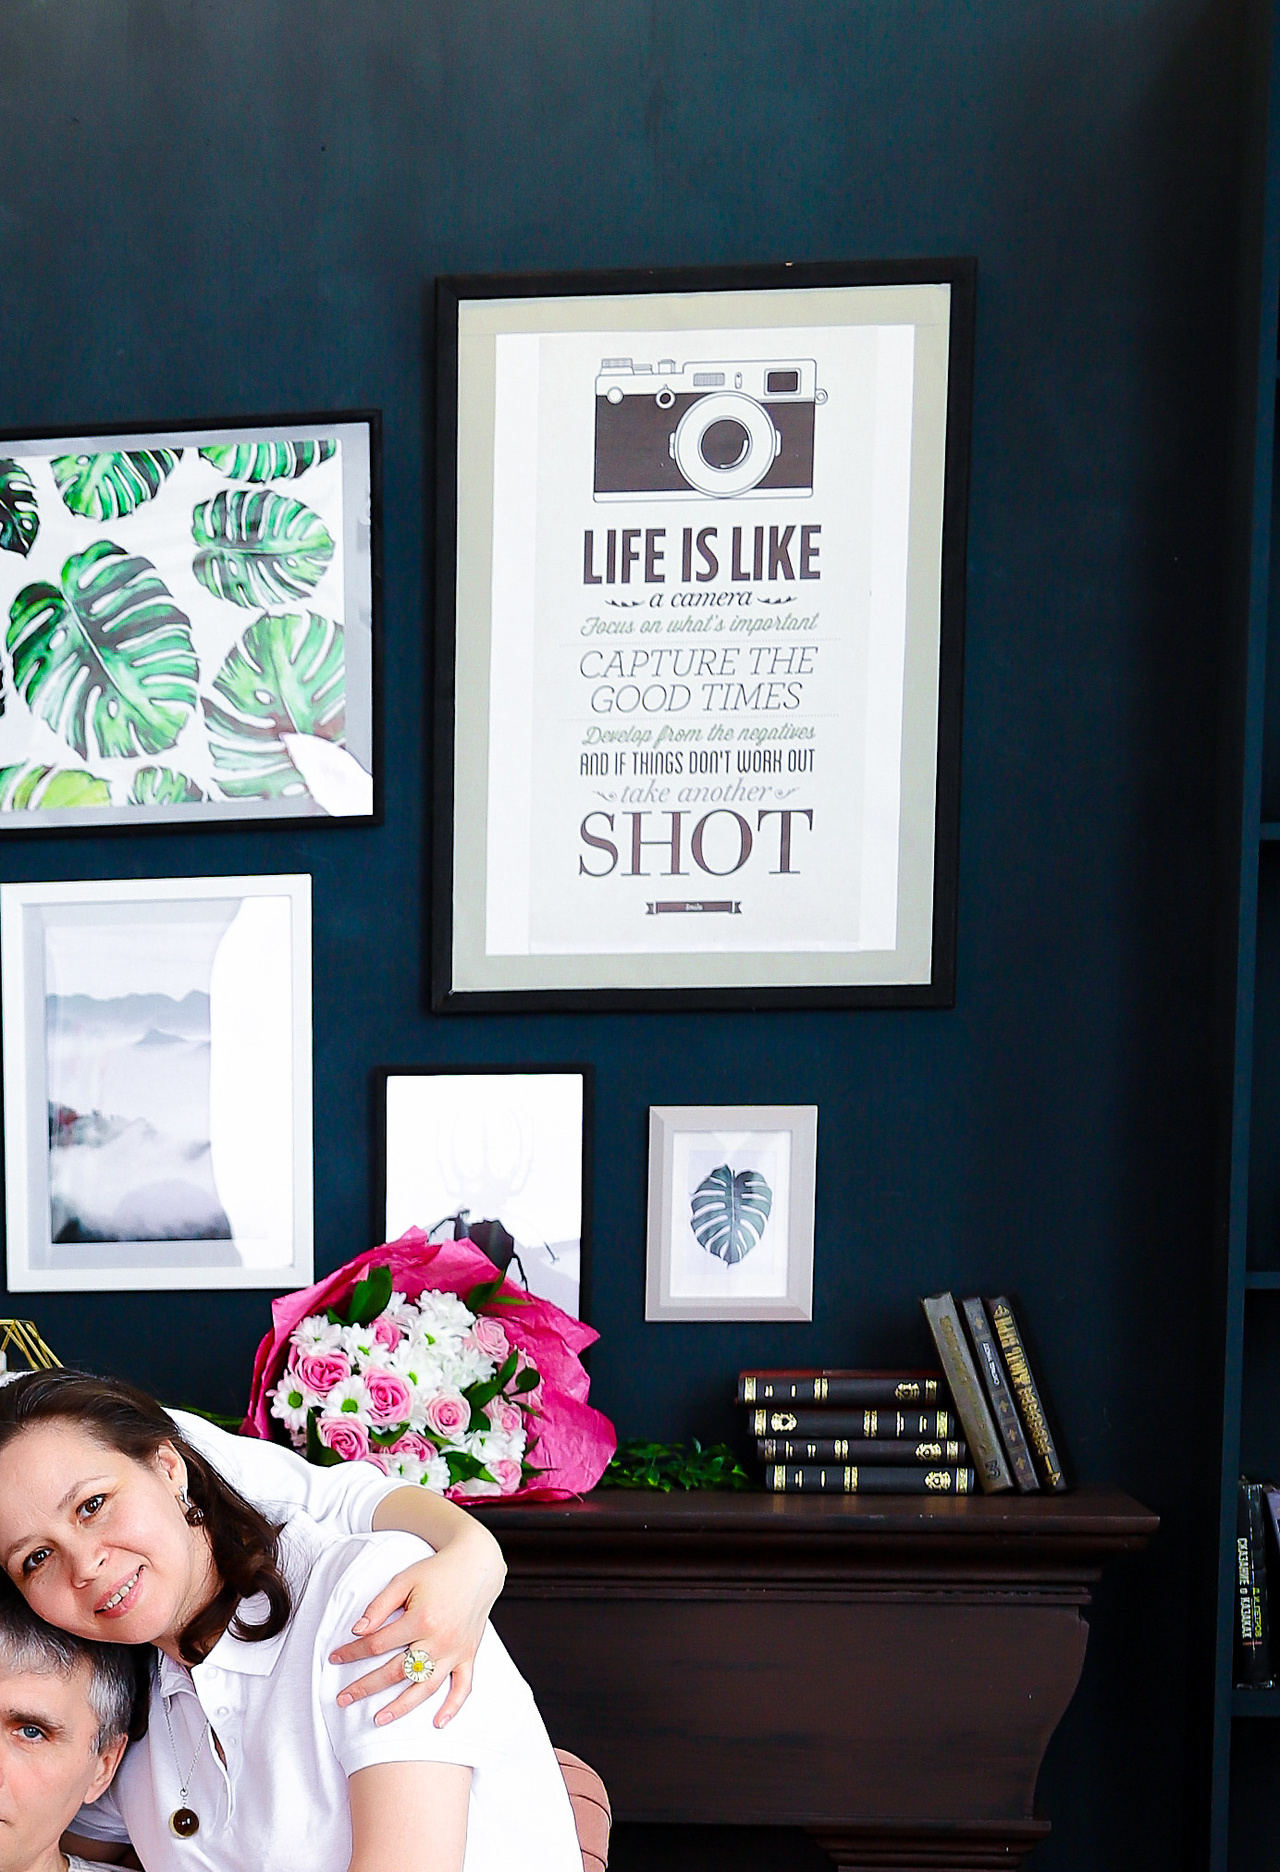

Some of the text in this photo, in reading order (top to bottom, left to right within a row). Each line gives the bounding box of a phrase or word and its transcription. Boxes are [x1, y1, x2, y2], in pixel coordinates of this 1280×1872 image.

[583, 524, 821, 585] LIFE IS LIKE
[649, 590, 753, 608] a camera
[580, 611, 820, 637] Focus on what's important
[579, 646, 818, 680] CAPTURE THE
[590, 682, 803, 714] GOOD TIMES
[581, 722, 816, 749] Develop from the negatives
[580, 748, 816, 776] AND IF THINGS DON'T WORK OUT
[621, 776, 775, 804] take another
[579, 809, 814, 877] SHOT
